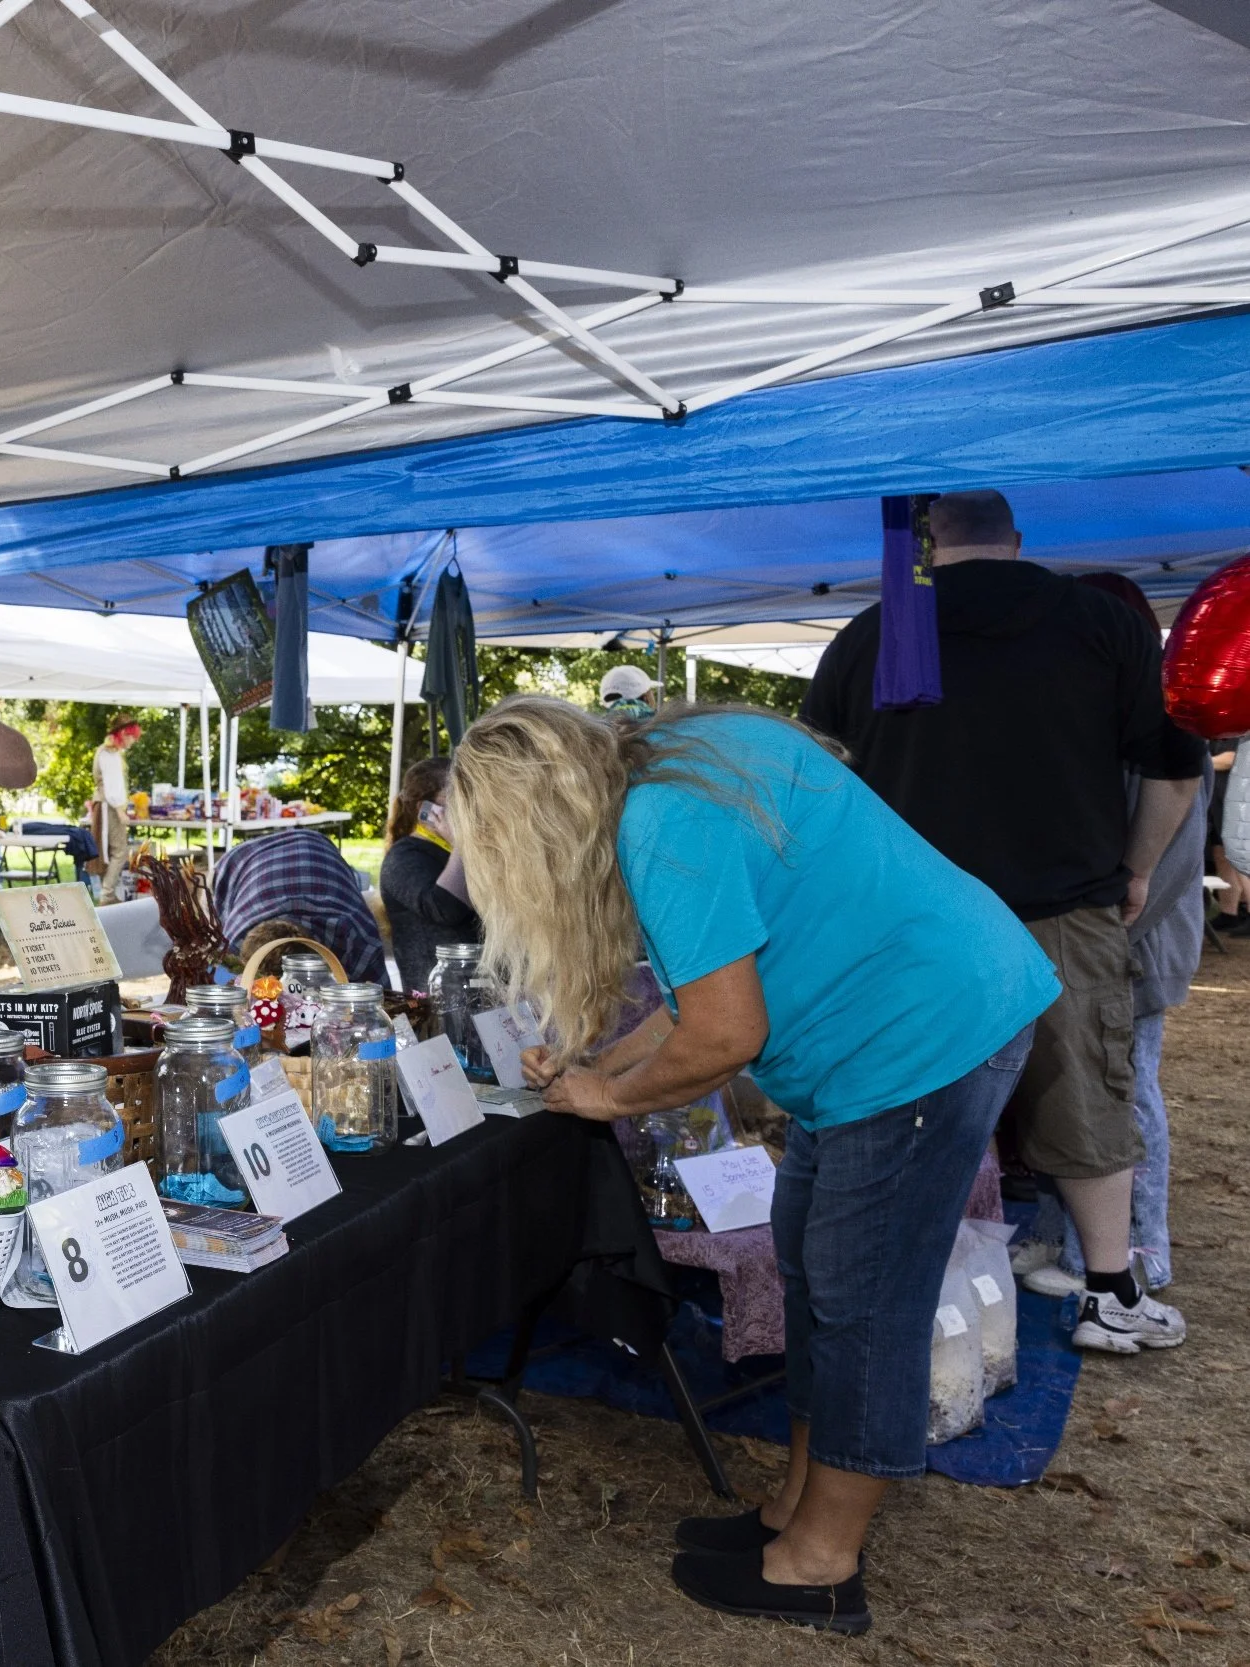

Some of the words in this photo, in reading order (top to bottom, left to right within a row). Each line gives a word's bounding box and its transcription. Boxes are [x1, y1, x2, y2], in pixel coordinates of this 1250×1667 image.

[30, 921, 51, 932] Raffle
[53, 919, 76, 929] Tickets
[26, 944, 46, 953] TICKET
[31, 954, 55, 964] TICKETS
[38, 964, 60, 974] TICKETS
[15, 1004, 22, 1012] IN
[26, 1004, 38, 1012] MY
[41, 1004, 58, 1012] KIT?
[73, 1004, 88, 1020] NORTH
[89, 1000, 103, 1015] SPORE
[76, 1028, 86, 1036] BLUE
[86, 1023, 101, 1033] OYSTER
[243, 1142, 271, 1180] 10
[702, 1185, 714, 1196] 15
[104, 1212, 120, 1223] MUSH,
[135, 1200, 148, 1211] PASS
[62, 1238, 88, 1282] 8
